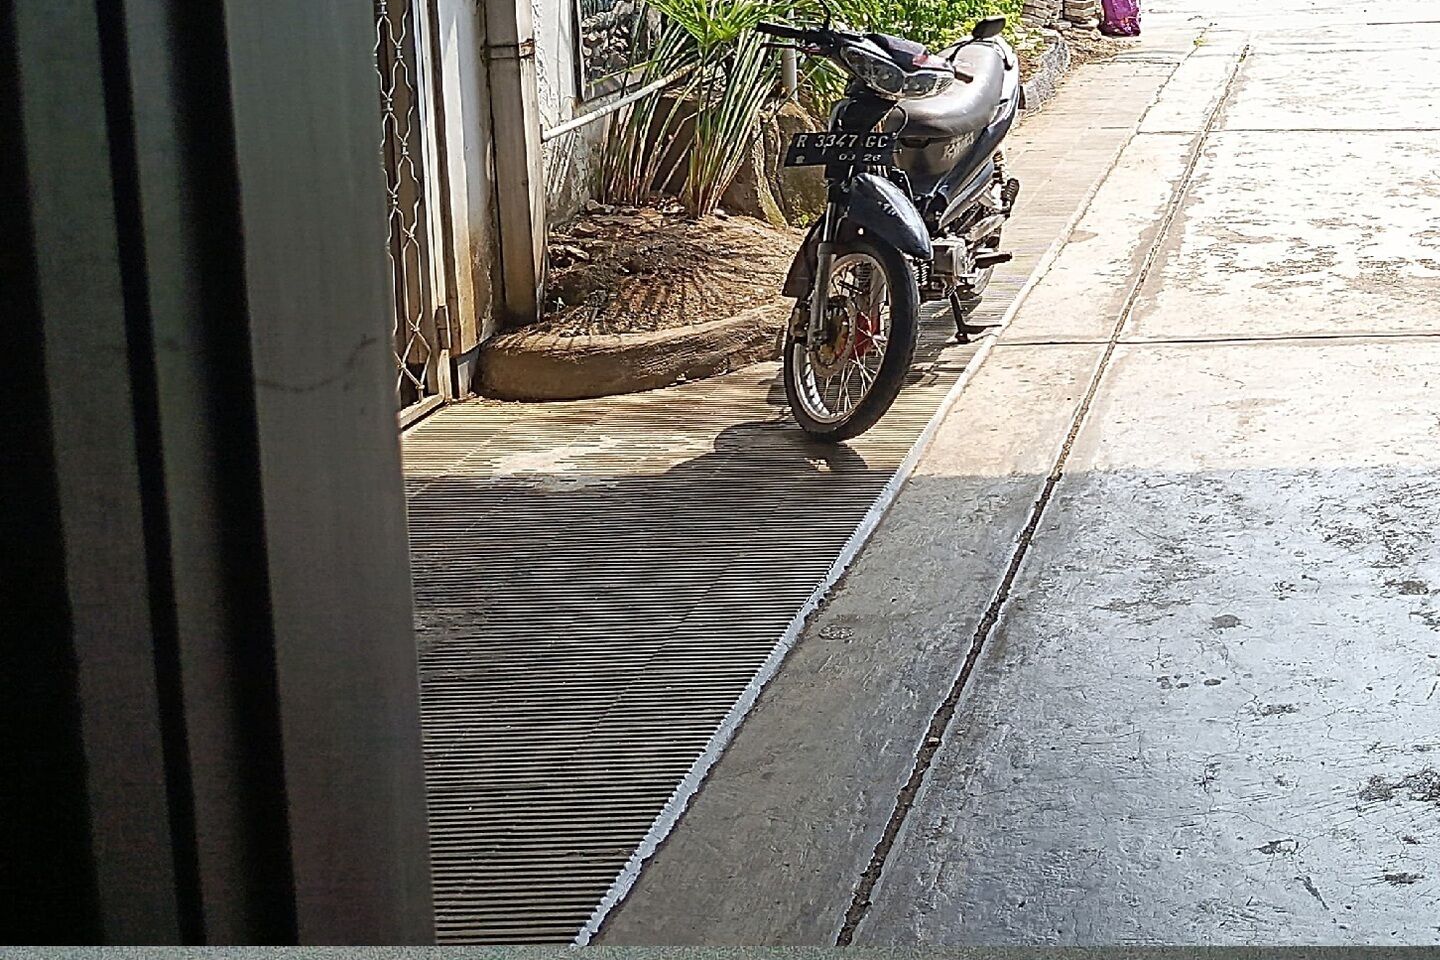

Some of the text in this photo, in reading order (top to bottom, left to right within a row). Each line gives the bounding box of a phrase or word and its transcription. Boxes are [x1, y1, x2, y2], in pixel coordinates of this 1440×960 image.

[796, 134, 888, 148] R 3347 GC
